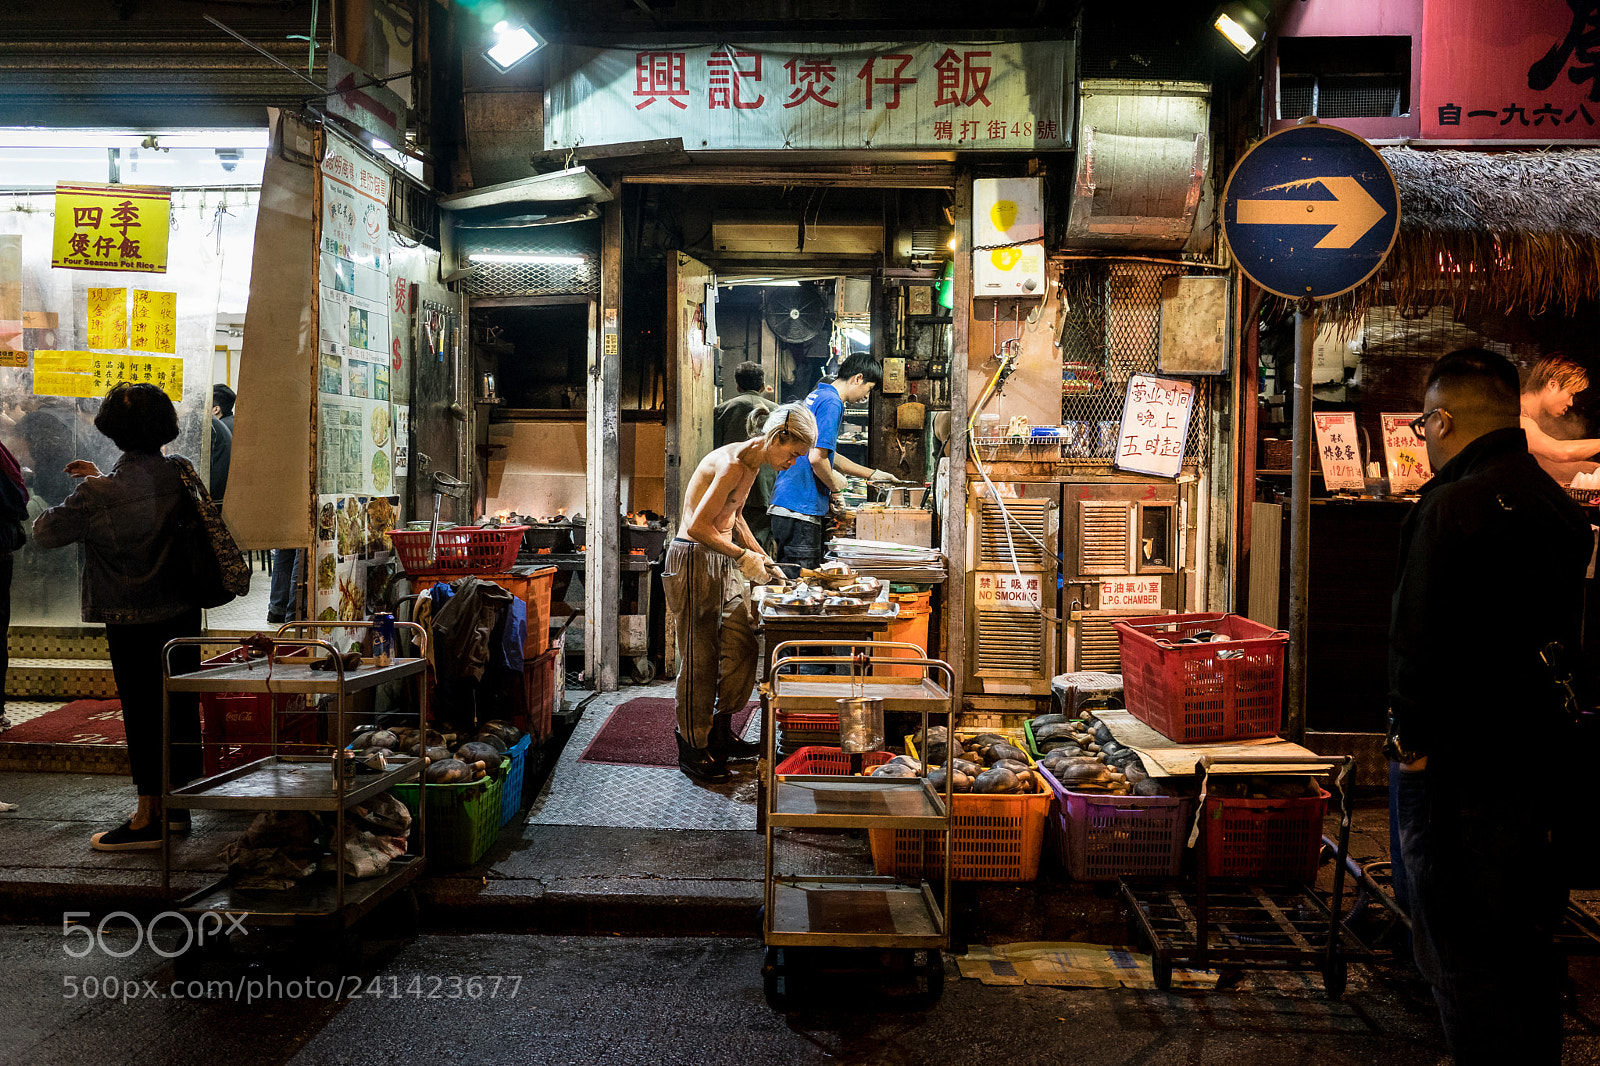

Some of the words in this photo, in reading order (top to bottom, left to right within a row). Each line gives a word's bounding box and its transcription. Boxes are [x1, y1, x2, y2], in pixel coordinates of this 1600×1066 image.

[632, 48, 993, 111] 興記煲仔飯
[1438, 103, 1595, 126] 自一九六八
[933, 119, 1058, 141] 鴉打街48號
[73, 200, 141, 237] 四季
[68, 232, 142, 259] 煲仔飯
[63, 257, 82, 265] Four
[84, 258, 118, 267] Seasons
[120, 259, 134, 268] Pot
[136, 261, 154, 269] Rice
[1136, 410, 1178, 430] 晚上
[1122, 434, 1181, 457] 五时起
[979, 577, 1038, 590] 禁止吸煙
[1102, 582, 1159, 594] 石油氣小室
[979, 592, 992, 600] NO
[1102, 596, 1121, 605] L.P.G.
[1122, 594, 1158, 605] CHAMBER
